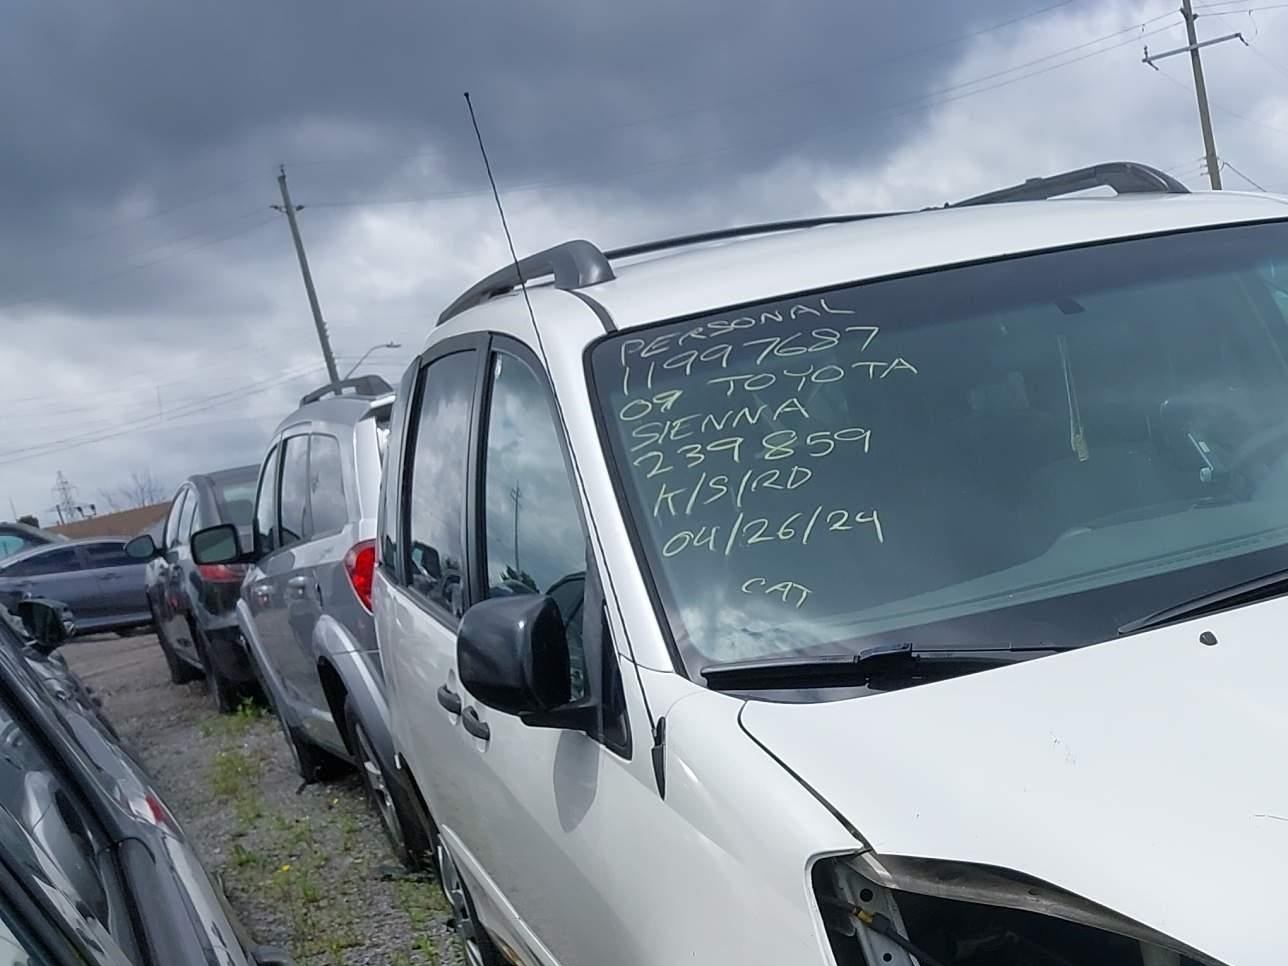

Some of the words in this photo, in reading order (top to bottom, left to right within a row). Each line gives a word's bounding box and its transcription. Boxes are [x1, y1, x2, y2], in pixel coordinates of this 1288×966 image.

[621, 299, 856, 366] PERSONAL
[623, 327, 879, 395] 11997687
[707, 358, 919, 396] TOYOTA
[631, 398, 810, 452] SIENNA
[741, 578, 813, 609] CAT
